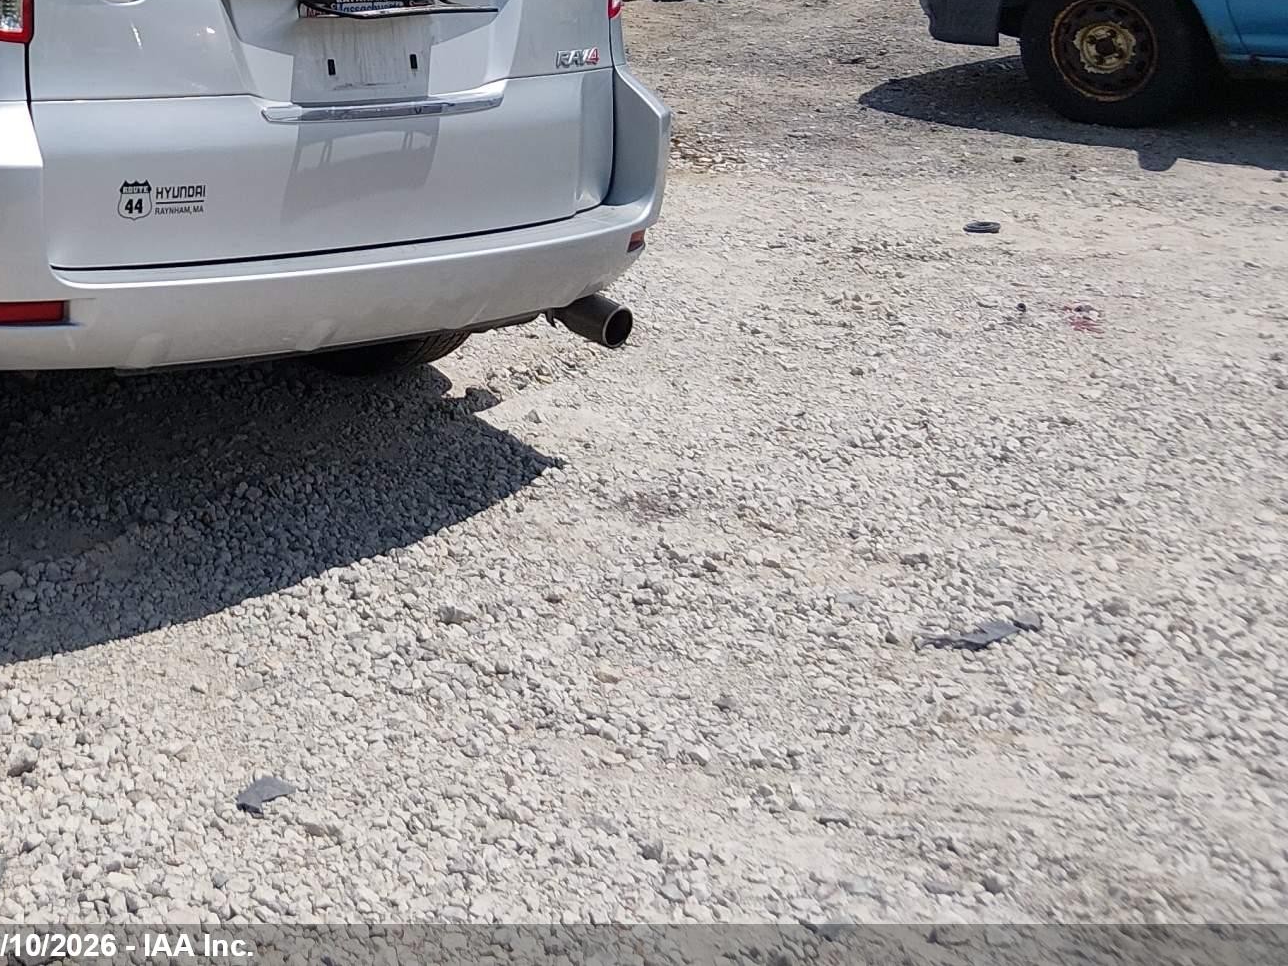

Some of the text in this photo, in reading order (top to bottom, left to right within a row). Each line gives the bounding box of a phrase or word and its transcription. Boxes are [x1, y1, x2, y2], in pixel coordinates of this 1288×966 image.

[556, 46, 600, 68] RAV4
[156, 185, 206, 199] HYUNDAI
[125, 198, 143, 214] 44
[155, 205, 204, 215] RAYNHAM, MA
